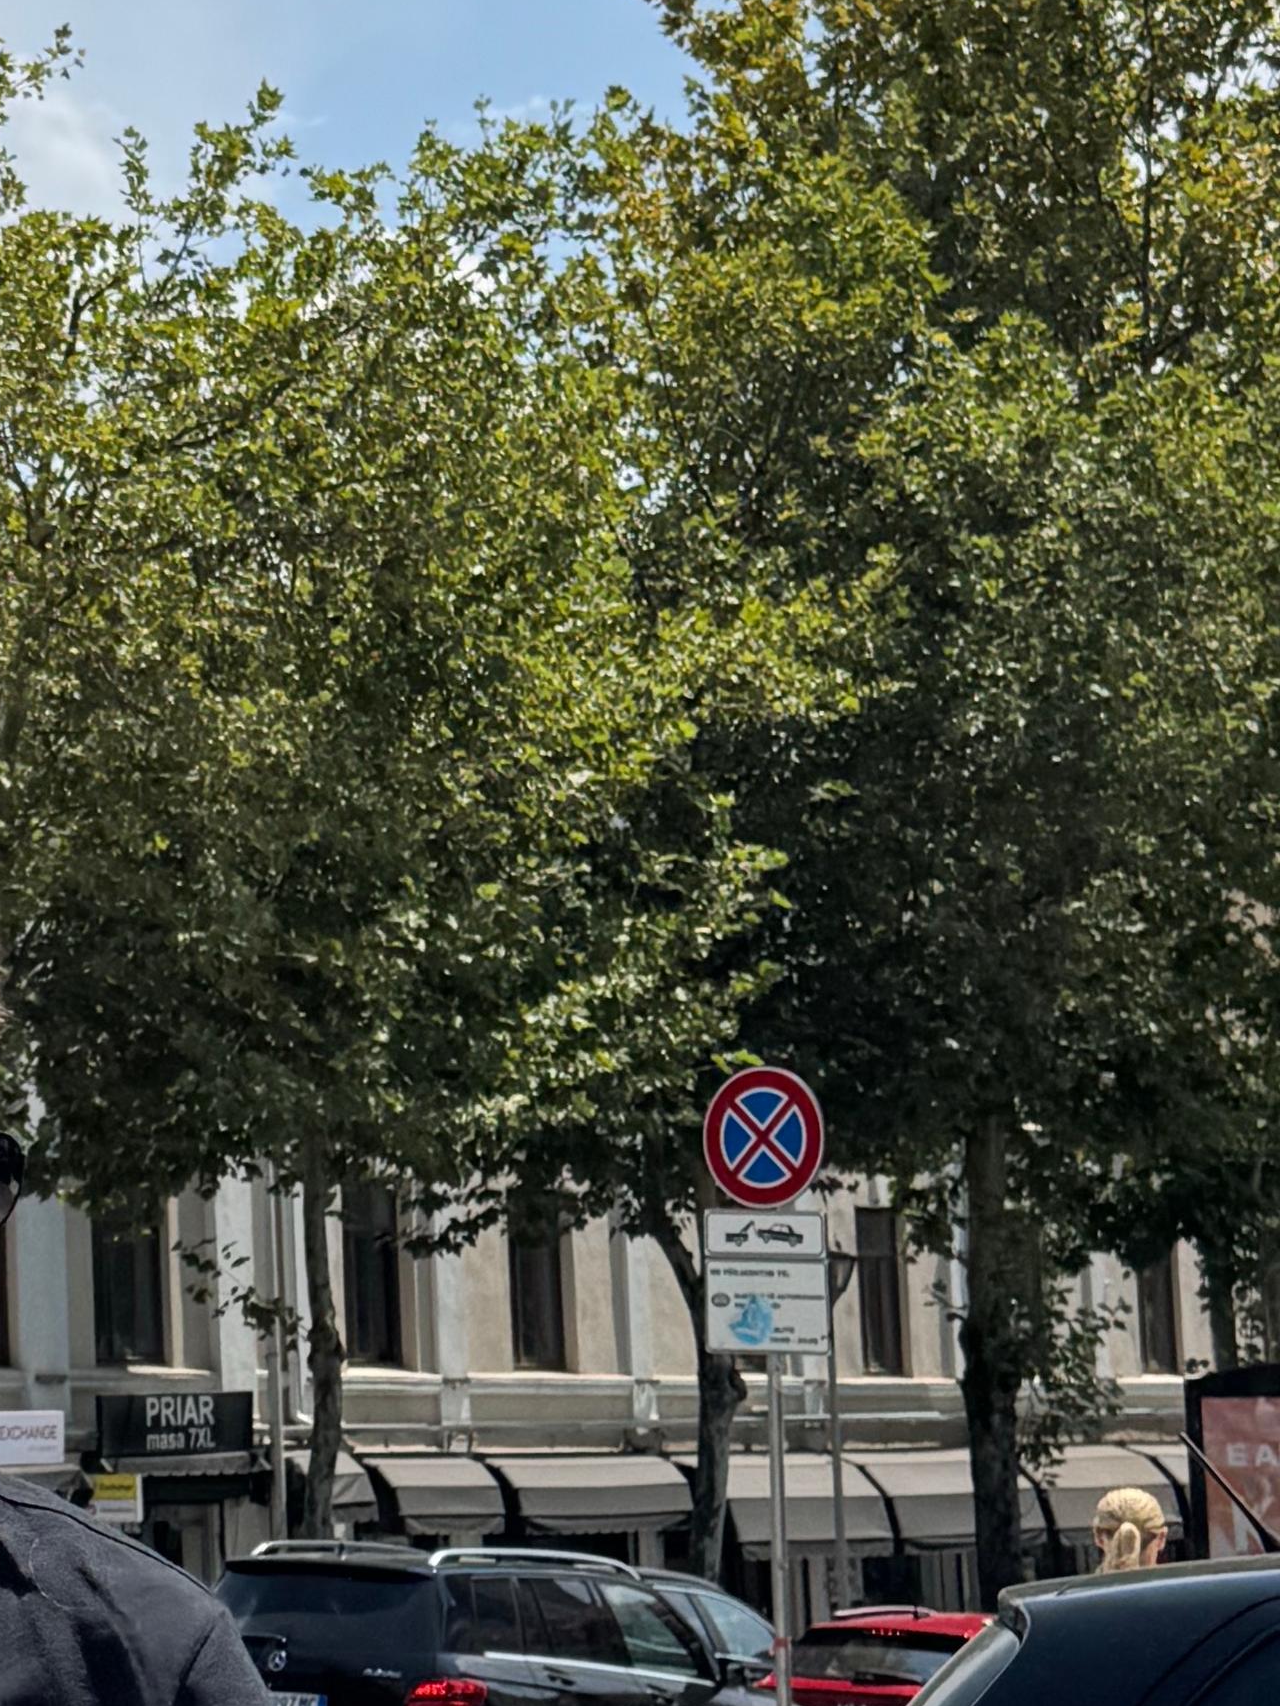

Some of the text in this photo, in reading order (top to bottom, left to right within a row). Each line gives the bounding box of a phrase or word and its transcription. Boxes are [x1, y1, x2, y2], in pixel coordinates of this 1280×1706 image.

[145, 1395, 216, 1427] PRIAR
[146, 1427, 216, 1451] masa 7XL
[1225, 1442, 1280, 1467] EA
